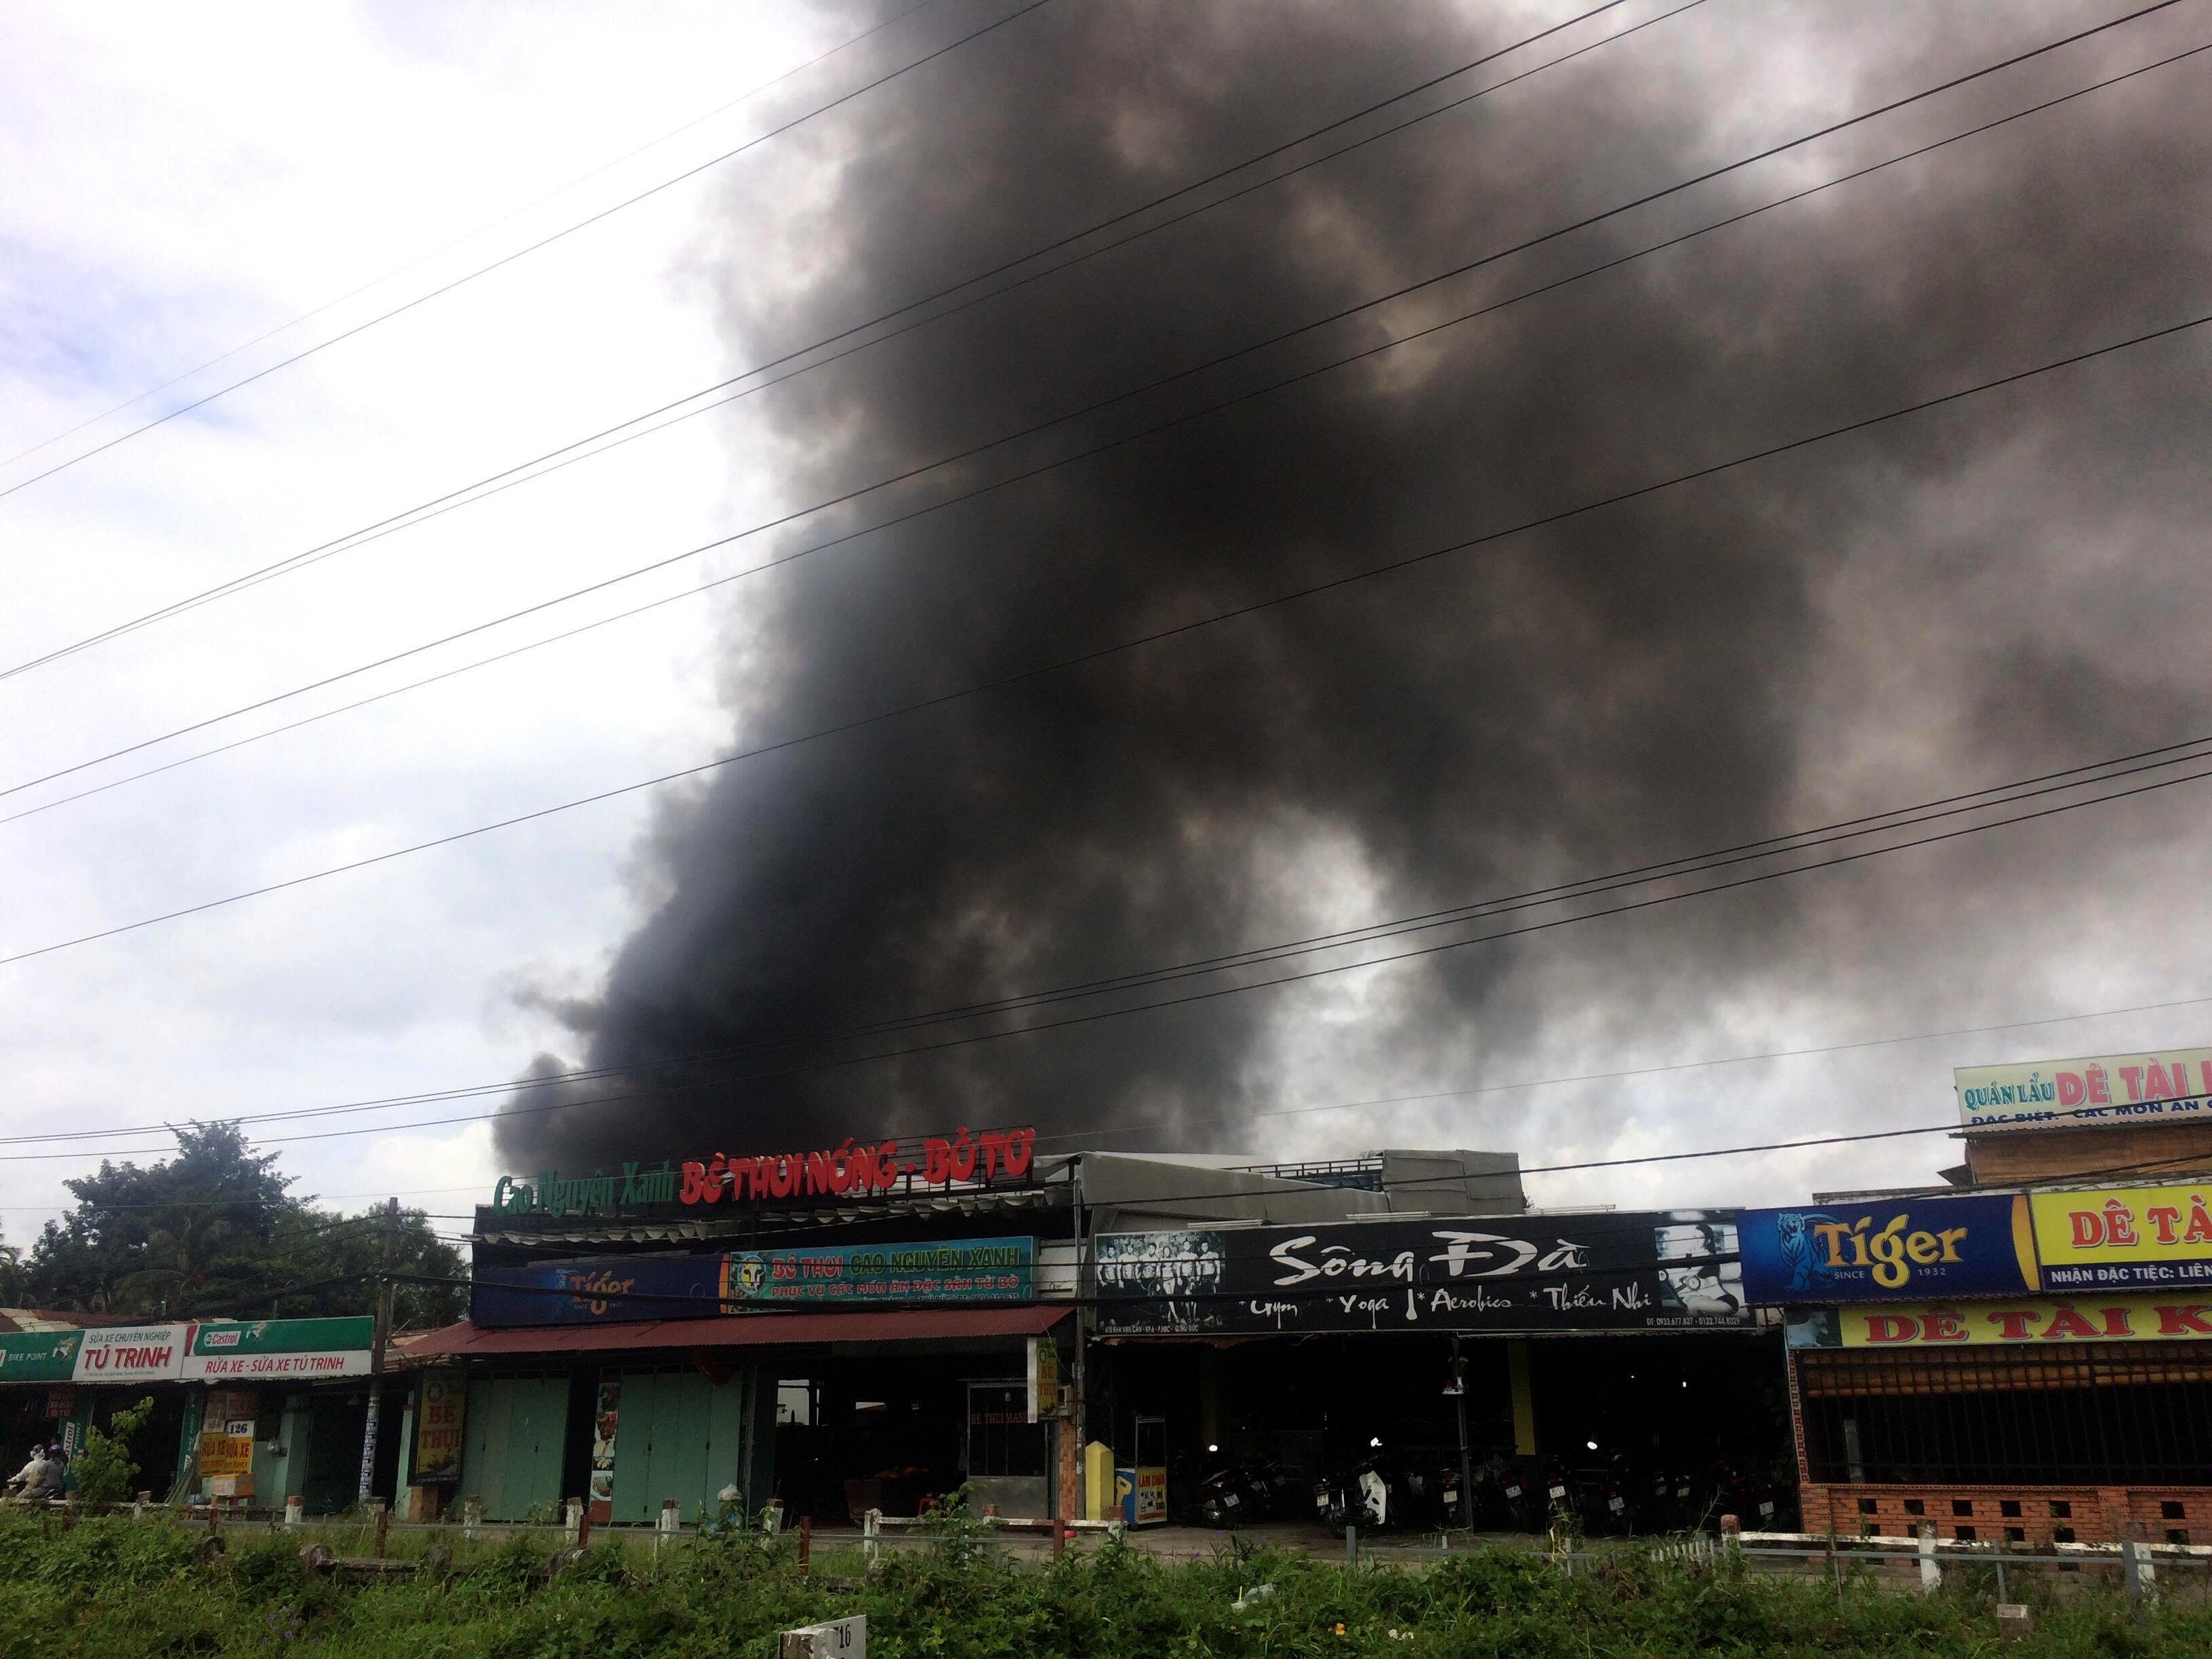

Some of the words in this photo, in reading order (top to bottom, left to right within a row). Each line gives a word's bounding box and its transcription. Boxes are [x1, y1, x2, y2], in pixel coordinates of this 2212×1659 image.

[1965, 1080, 2014, 1111] QUÁN
[2019, 1071, 2055, 1103] LẨU
[2055, 1062, 2110, 1107] DÊ
[2118, 1057, 2189, 1103] TÀI
[679, 1152, 724, 1204] BÊ
[729, 1154, 804, 1200] THUI
[807, 1137, 898, 1194] NÓNG
[493, 1176, 533, 1216] Cao
[536, 1168, 615, 1218] Nguyên
[620, 1160, 674, 1205] Xanh
[2068, 1198, 2139, 1248] DÊ
[772, 1253, 796, 1279] BÊ
[800, 1255, 844, 1278] THUI
[850, 1252, 886, 1275] CAO
[889, 1244, 964, 1274] NGUYÊN
[968, 1246, 1019, 1269] XANH
[1814, 1214, 1968, 1288] Tiger
[771, 1286, 804, 1299] PHỤC
[808, 1285, 825, 1299] VỤ
[829, 1281, 853, 1295] CÁC
[856, 1279, 886, 1294] MÓN
[944, 1275, 972, 1292] SẢN
[997, 1275, 1019, 1288] BÒ
[1269, 1235, 1418, 1321] Sông
[1429, 1231, 1591, 1277] Đà
[1835, 1271, 1865, 1279] SINCE
[1918, 1267, 1946, 1276] 1932
[2051, 1267, 2093, 1284] NHẬN
[2097, 1267, 2129, 1283] ĐẶC
[2133, 1265, 2174, 1283] TIỆC:
[2179, 1263, 2212, 1278] LIÊN
[569, 1271, 635, 1315] Tiger
[1250, 1300, 1297, 1329] Gym
[1339, 1294, 1389, 1329] Yoga
[1431, 1285, 1512, 1312] Aerobics
[1612, 1281, 1652, 1311] Nhi
[212, 1333, 237, 1345] Castrol
[1864, 1306, 1969, 1343] DÊ
[1987, 1303, 2134, 1340] TÀI
[26, 1353, 47, 1361] POINT
[115, 1346, 173, 1369] TRINH
[205, 1357, 228, 1373] RỬA
[230, 1361, 243, 1372] XE
[251, 1355, 272, 1372] SỬA
[276, 1359, 289, 1371] XE
[310, 1357, 345, 1370] TRINH
[229, 1423, 247, 1434] 126
[239, 1442, 249, 1458] XE
